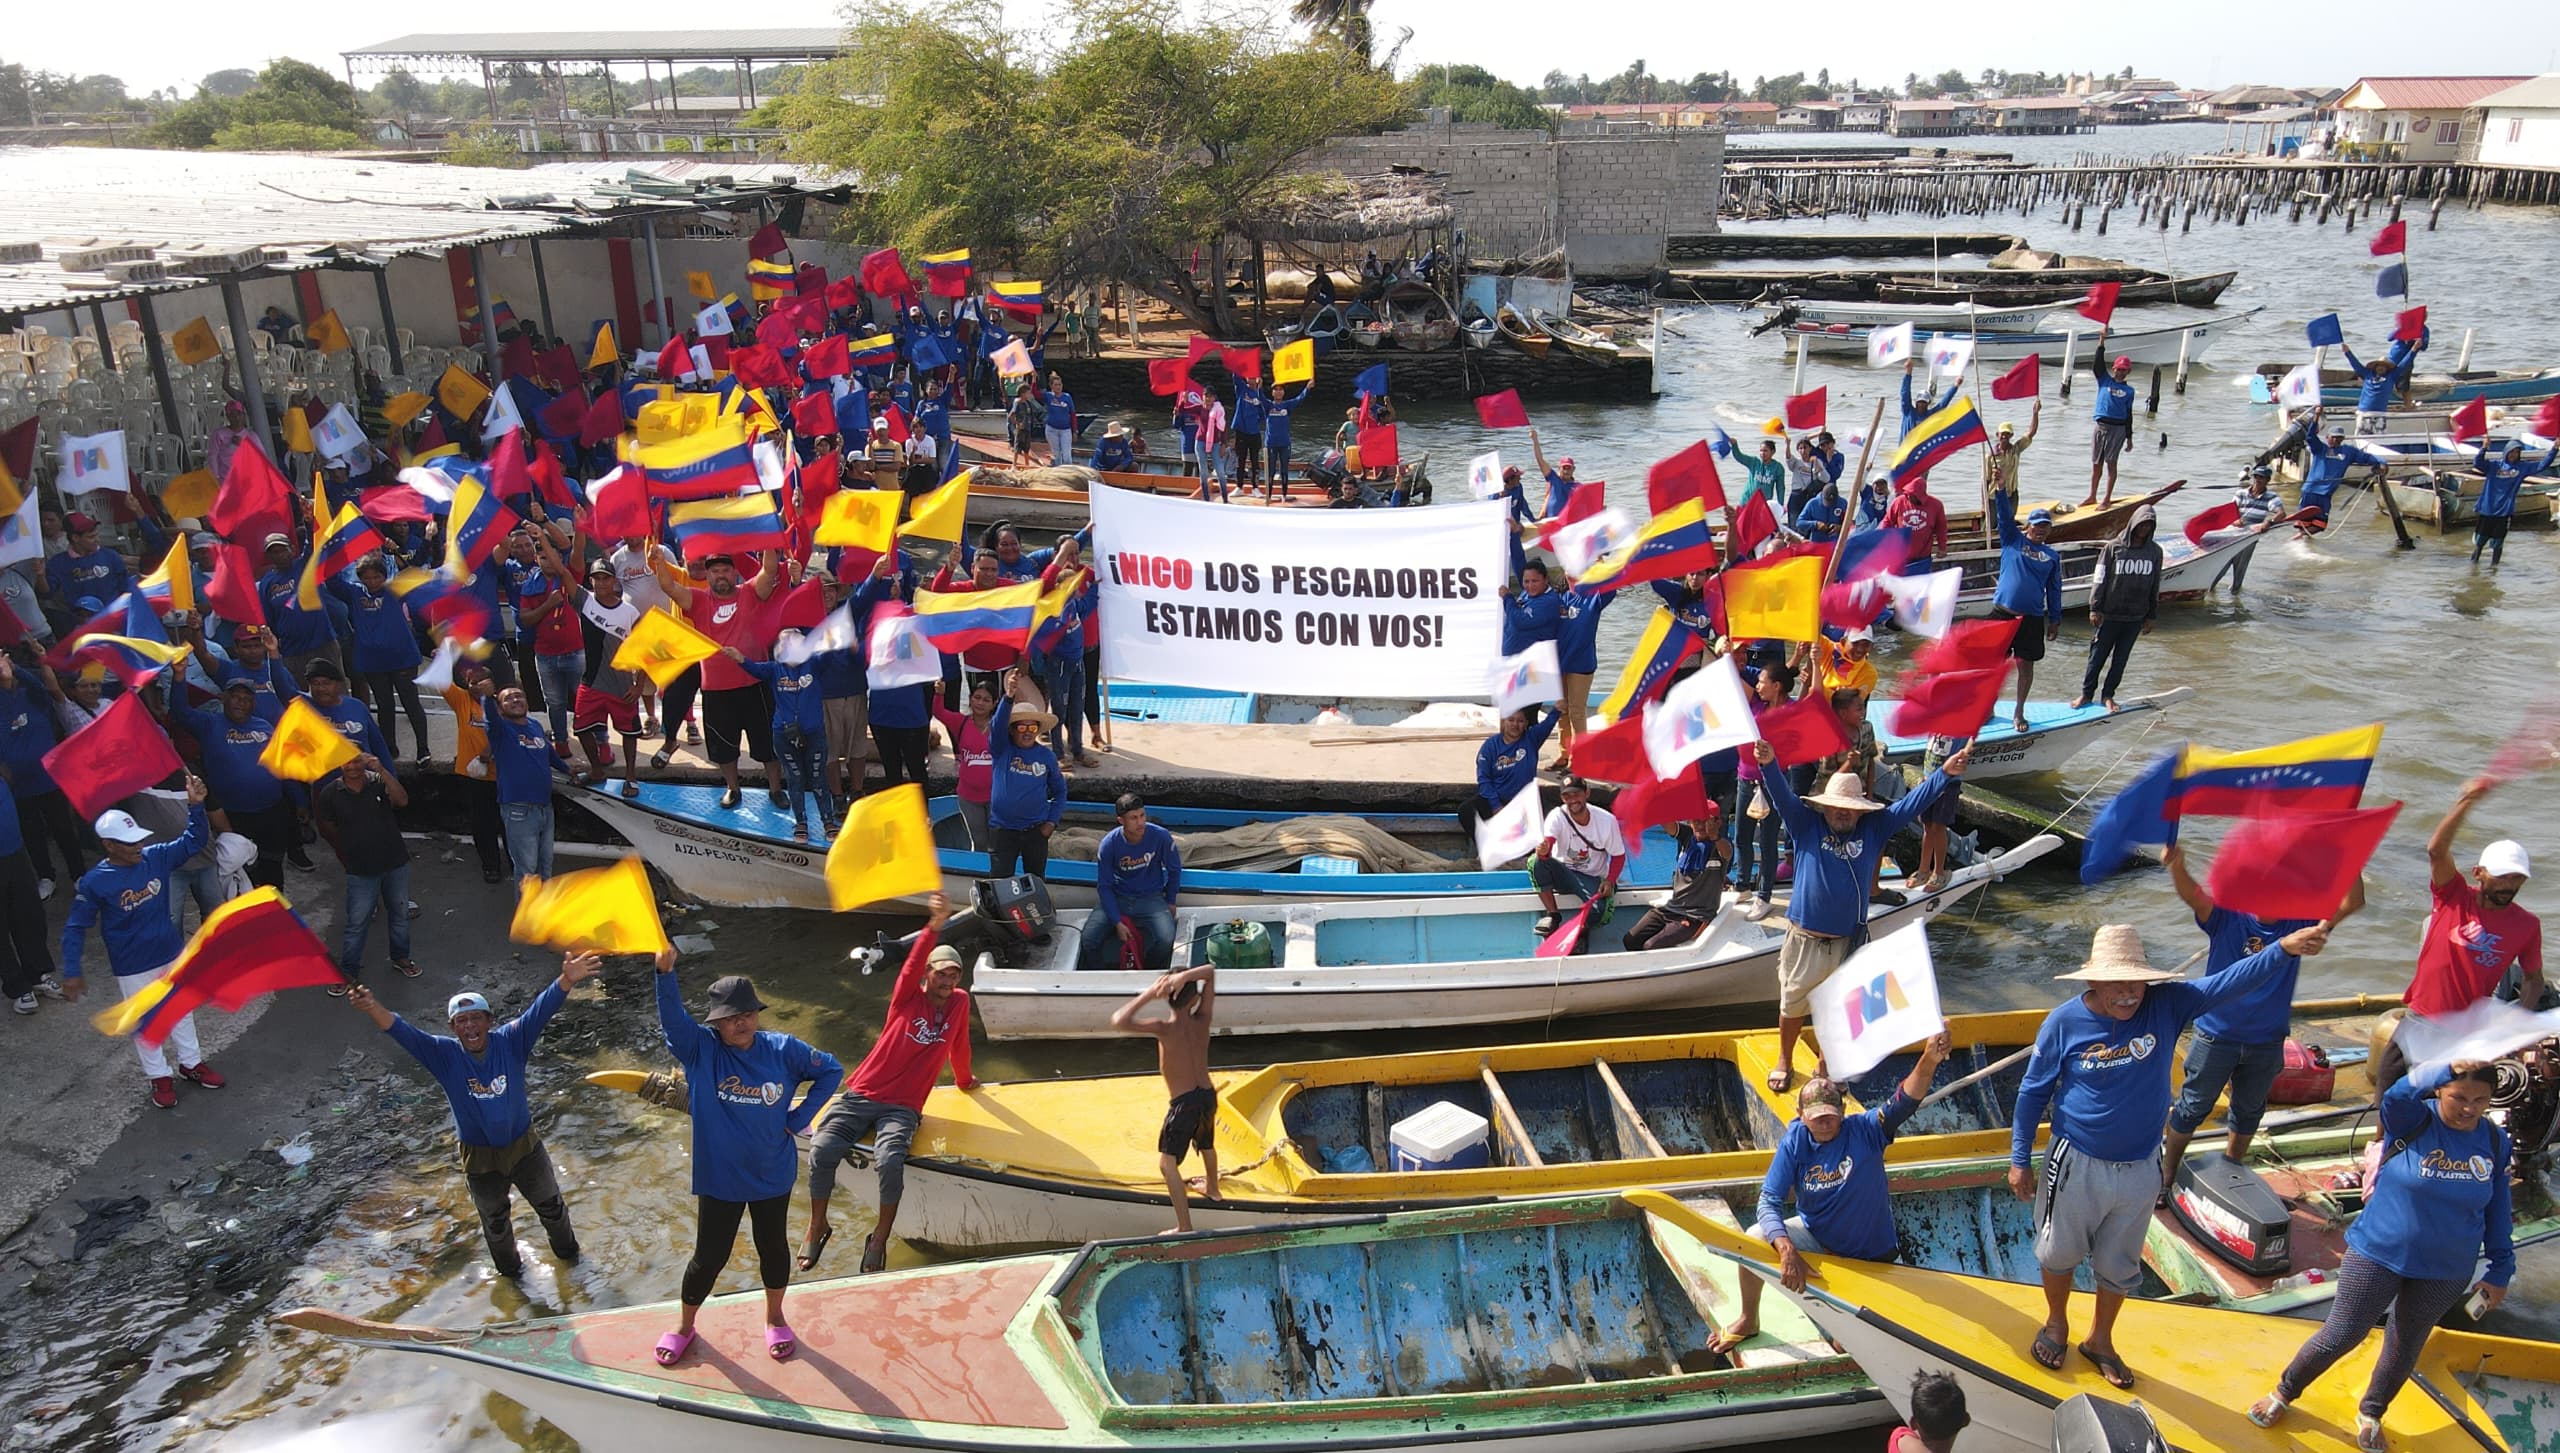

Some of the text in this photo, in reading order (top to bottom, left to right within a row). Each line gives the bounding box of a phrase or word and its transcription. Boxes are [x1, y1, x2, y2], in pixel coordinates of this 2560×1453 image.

[1108, 551, 1479, 599] ¡NICO LOS PESCADORES
[1145, 600, 1444, 648] ESTAMOS CON VOS!
[123, 817, 134, 829] B
[2080, 1042, 2130, 1060] Pesca
[2081, 1059, 2094, 1069] TU
[718, 1075, 762, 1097] Pesca
[2421, 1148, 2471, 1171] Pesca
[2421, 1167, 2435, 1177] TU
[2265, 1238, 2285, 1253] 40
